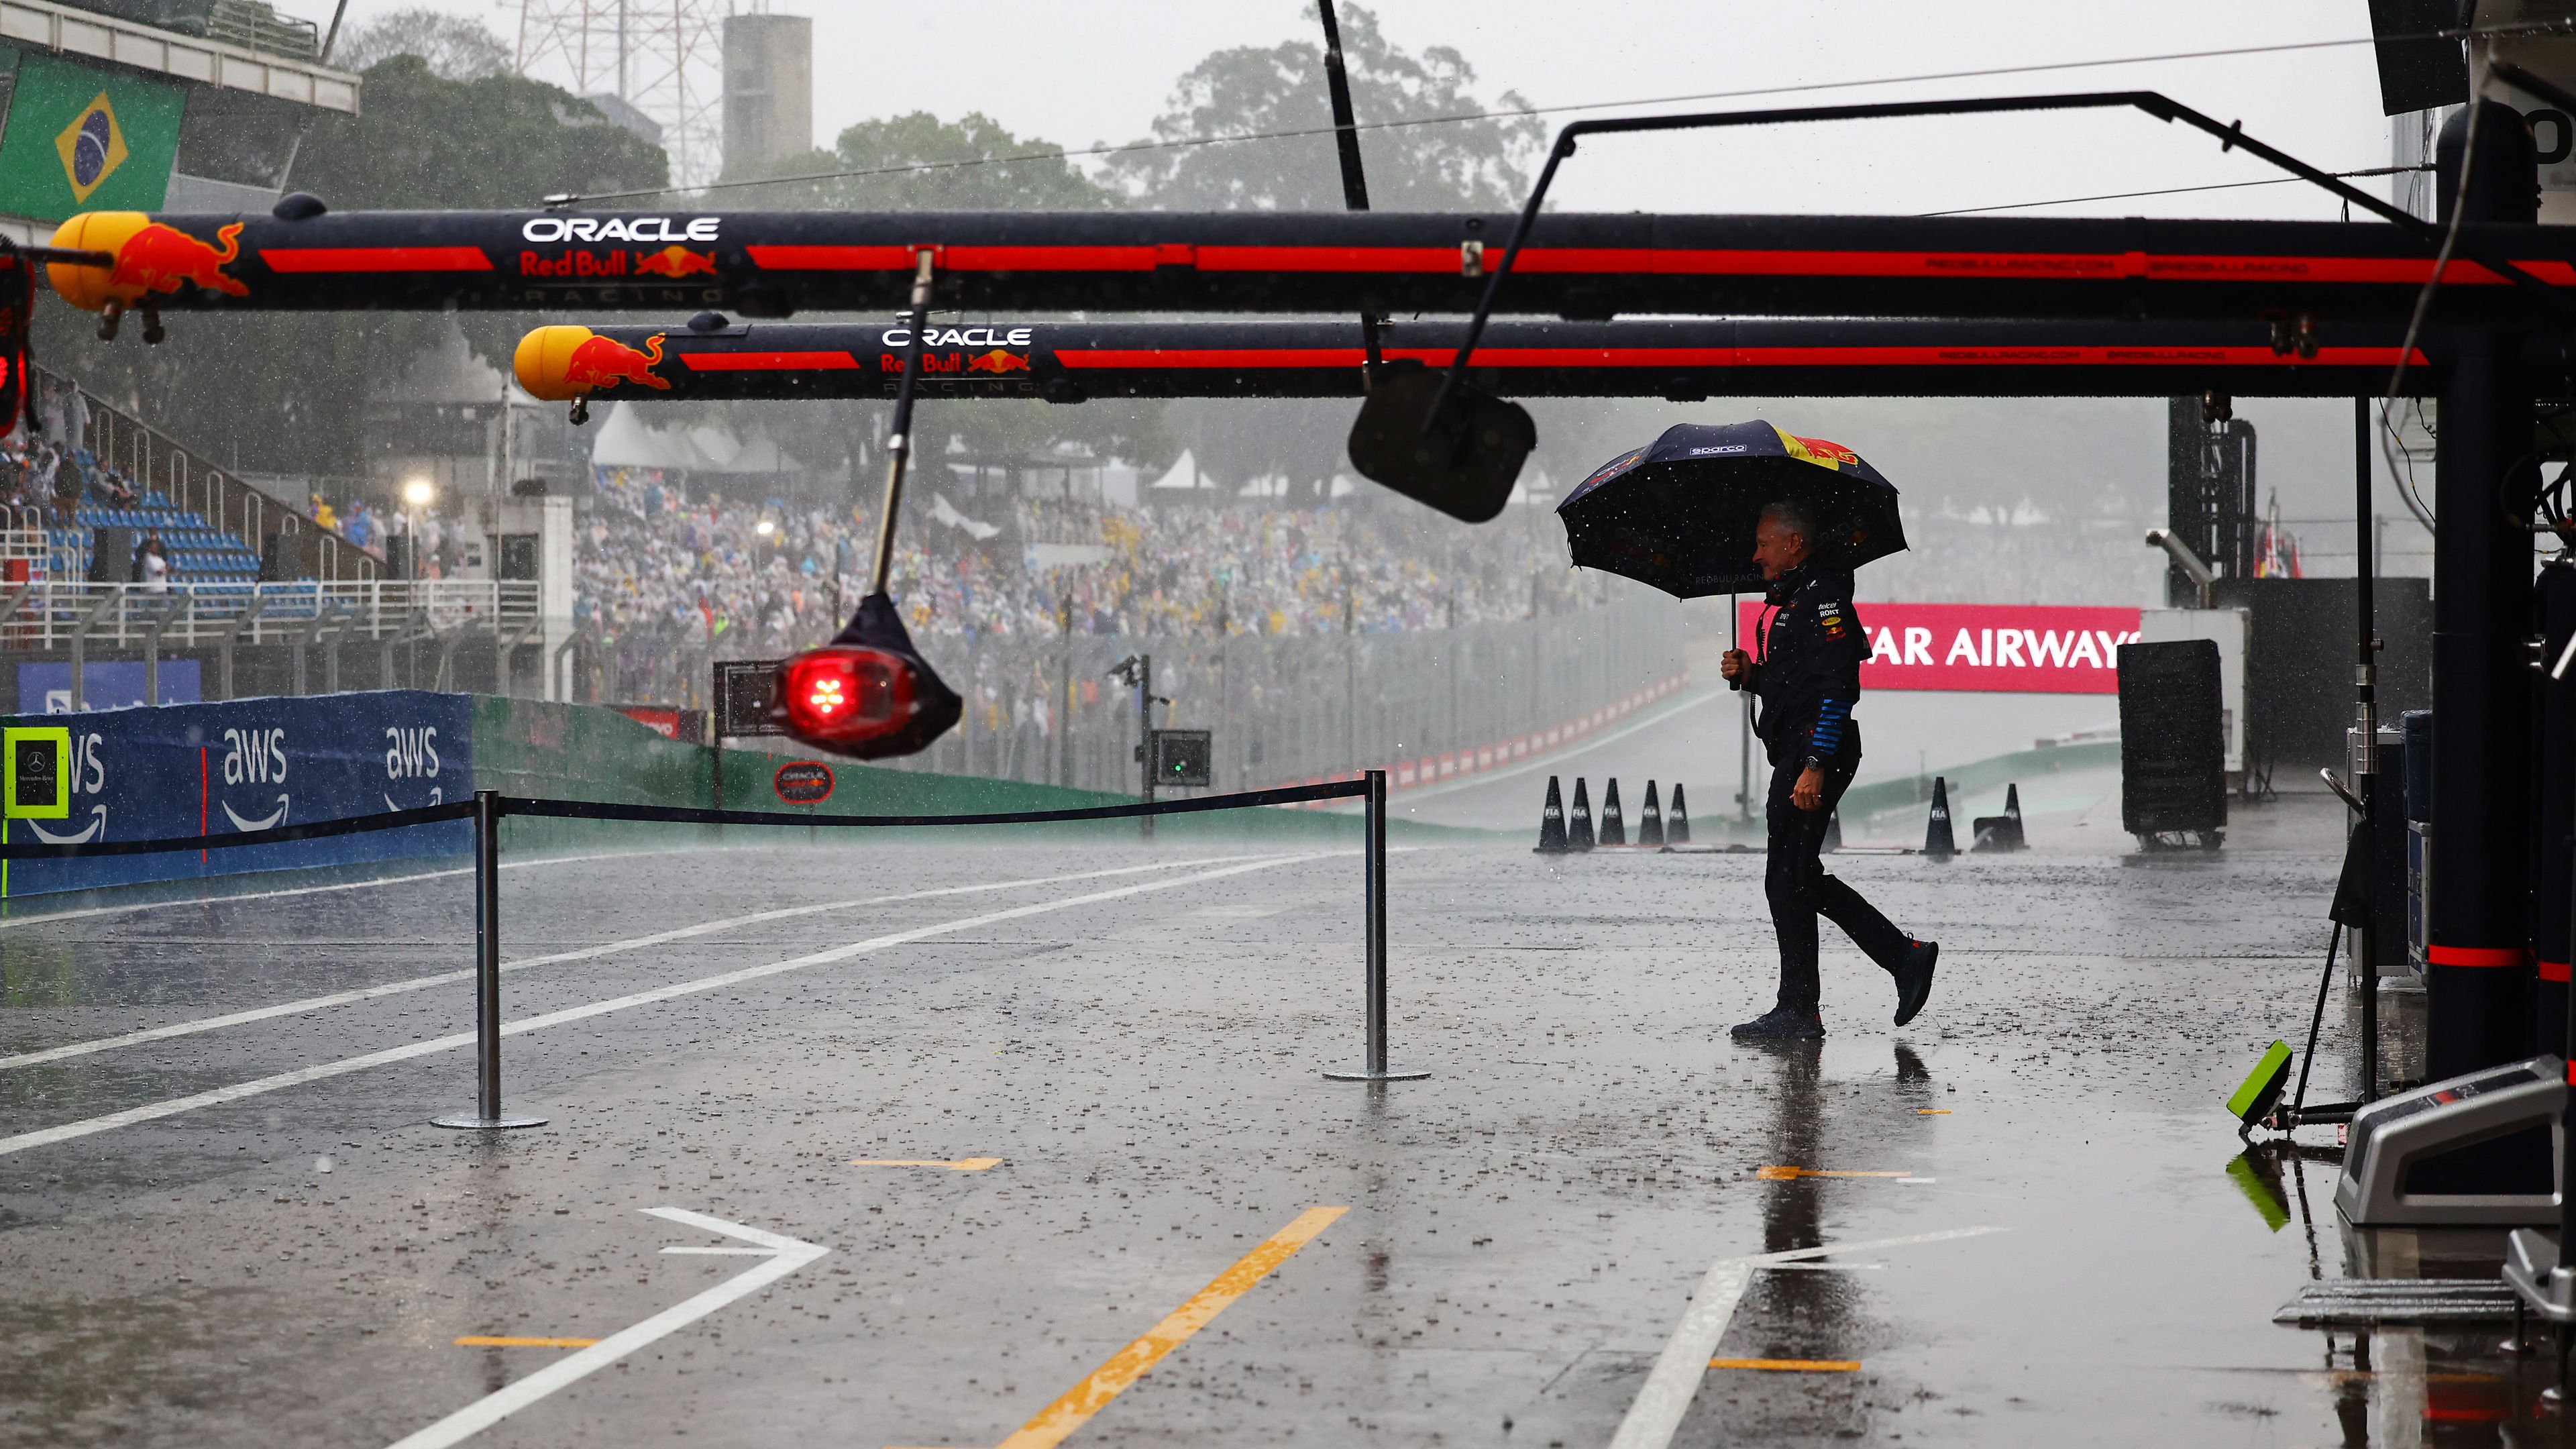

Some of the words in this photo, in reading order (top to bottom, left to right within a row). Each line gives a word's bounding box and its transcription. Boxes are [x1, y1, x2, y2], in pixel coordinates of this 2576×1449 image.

[523, 218, 721, 242] ORACLE
[520, 250, 572, 276] Red
[576, 250, 627, 276] Bull
[524, 290, 722, 303] RACING
[922, 353, 960, 372] Bull
[883, 382, 1034, 393] RACING
[1818, 602, 1837, 610] telcel
[1819, 609, 1839, 618] ROKT
[1945, 628, 2141, 669] AIRWAY
[224, 728, 287, 785] aws
[386, 727, 439, 780] aws
[1545, 808, 1560, 817] FIA
[1572, 808, 1587, 817] FIA
[1604, 808, 1618, 816] FIA
[1931, 810, 1946, 818] FIA
